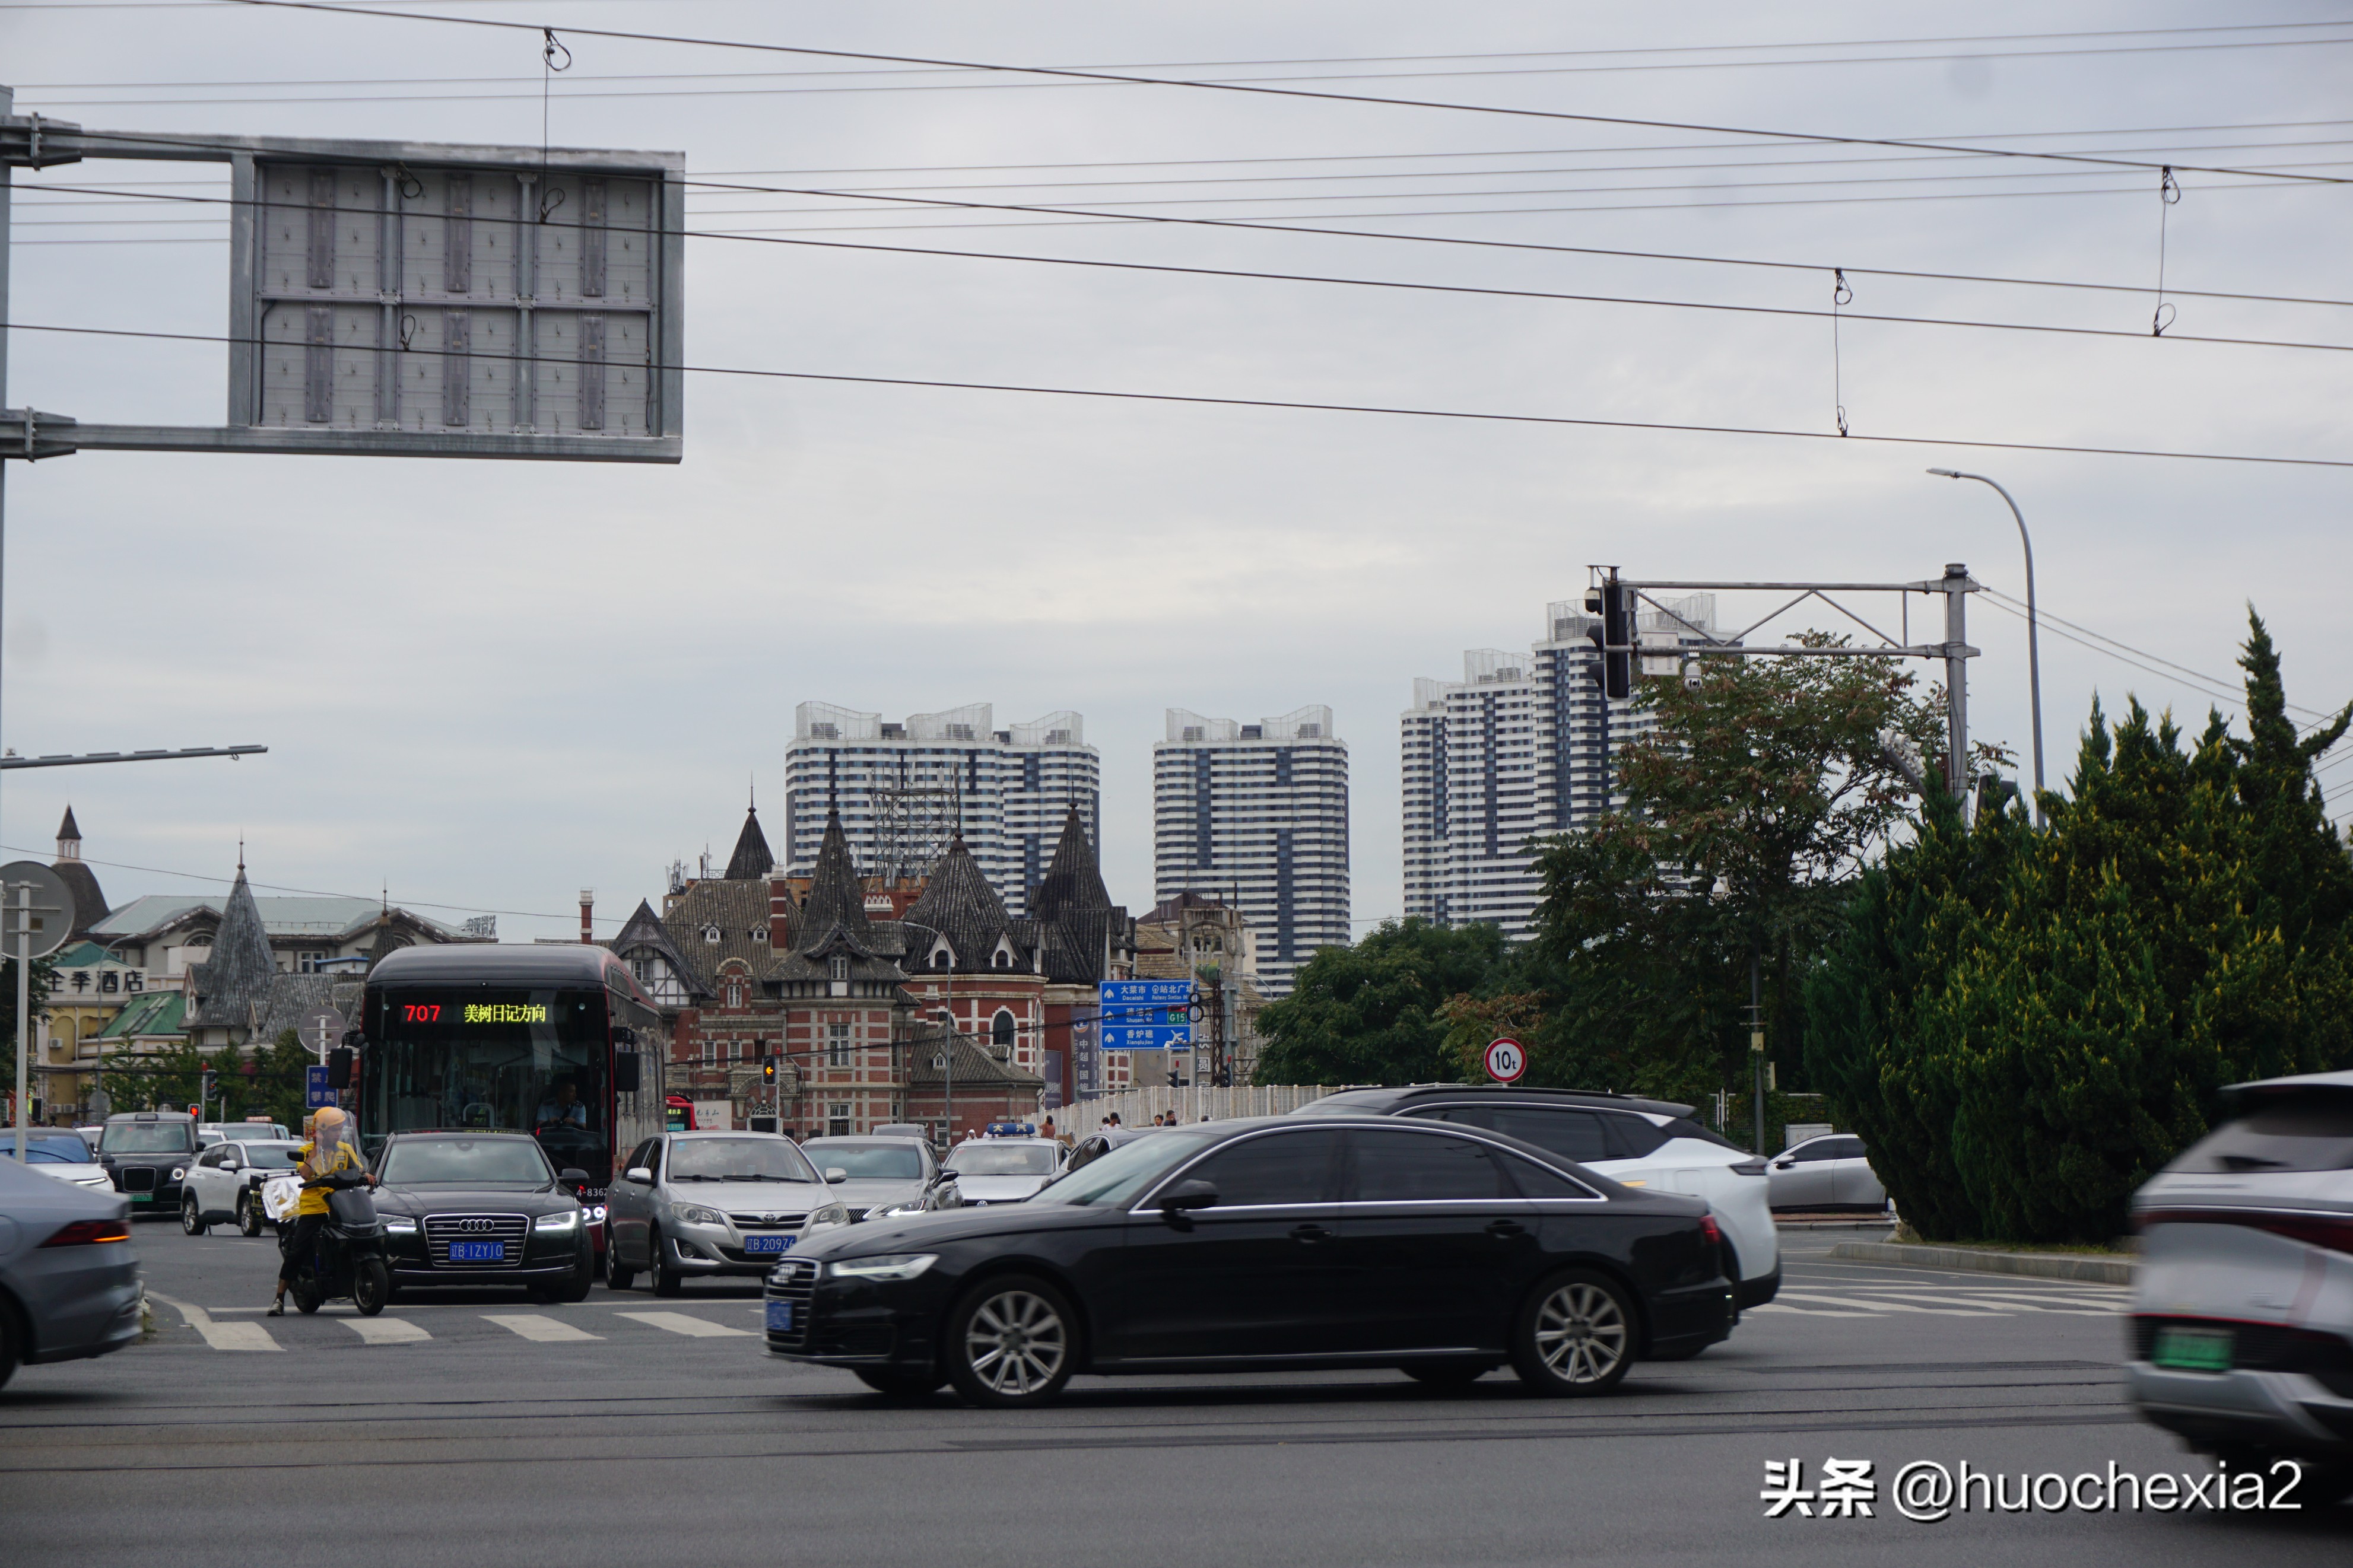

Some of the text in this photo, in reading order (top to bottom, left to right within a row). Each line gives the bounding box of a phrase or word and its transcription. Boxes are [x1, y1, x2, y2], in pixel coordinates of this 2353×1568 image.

[46, 970, 143, 993] 全季酒店
[1120, 985, 1146, 994] 大菜市
[404, 1004, 545, 1022] 707 美树日记方向
[1169, 1013, 1185, 1022] G15
[1126, 1029, 1153, 1038] 香炉礁
